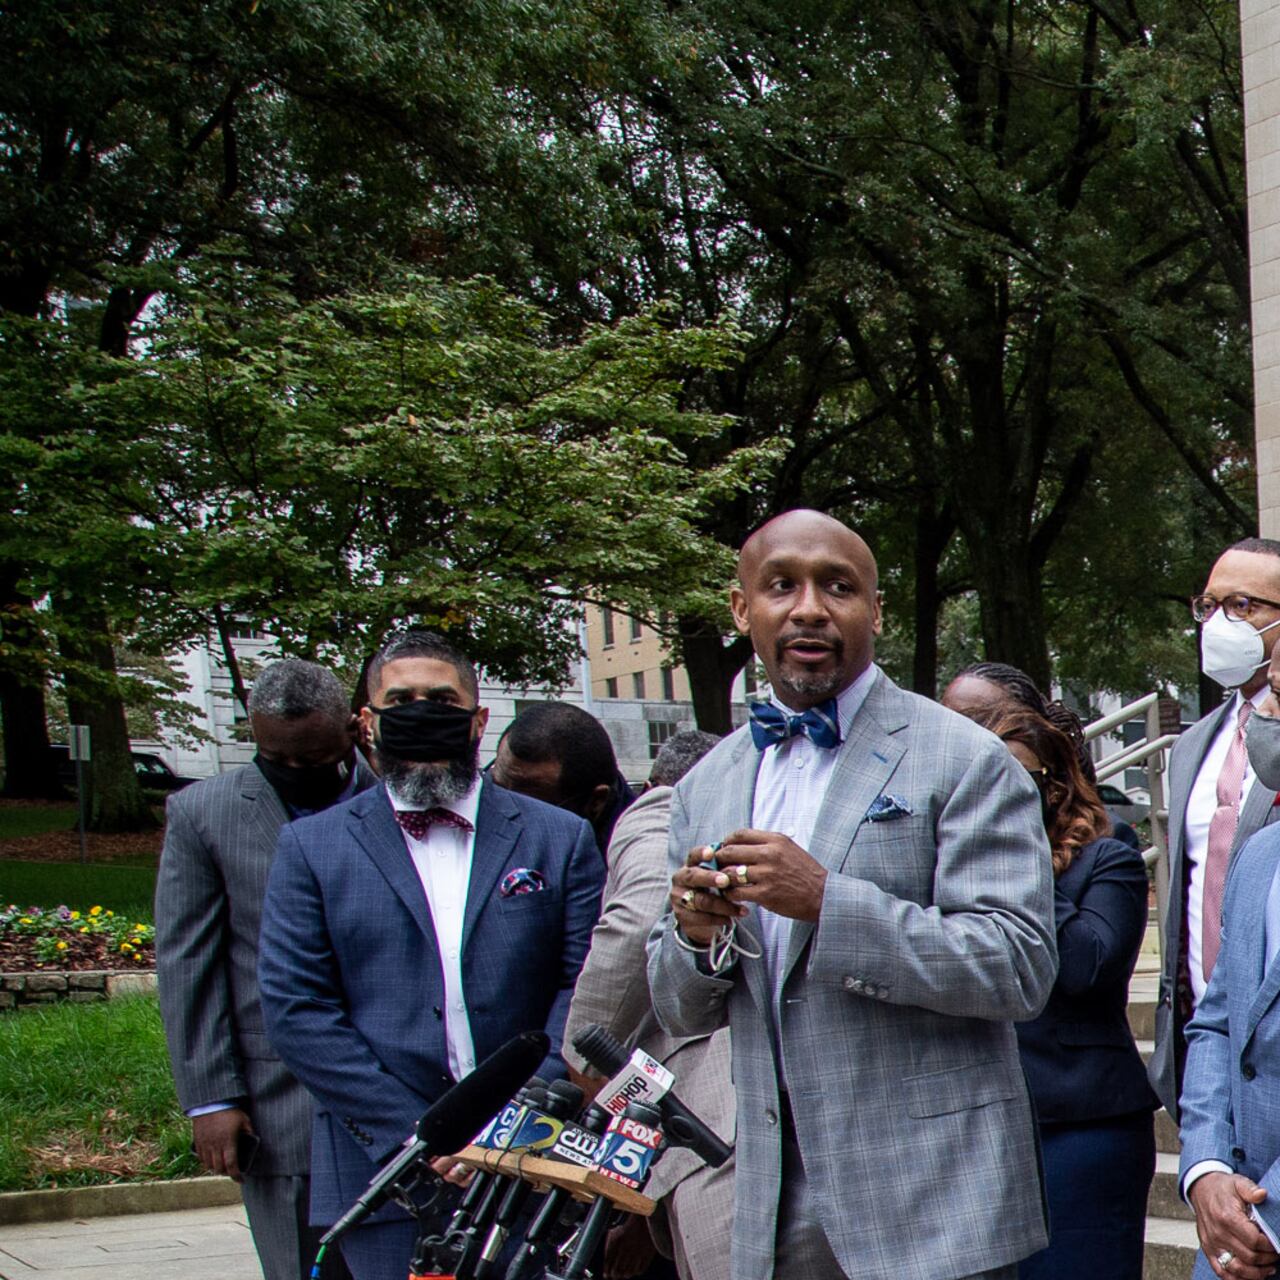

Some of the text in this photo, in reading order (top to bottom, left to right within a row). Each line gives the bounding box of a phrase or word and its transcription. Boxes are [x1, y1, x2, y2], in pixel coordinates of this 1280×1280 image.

[621, 1118, 661, 1147] FOX
[560, 1148, 581, 1160] NEWS
[612, 1139, 648, 1174] 5
[599, 1167, 640, 1189] NEWS
